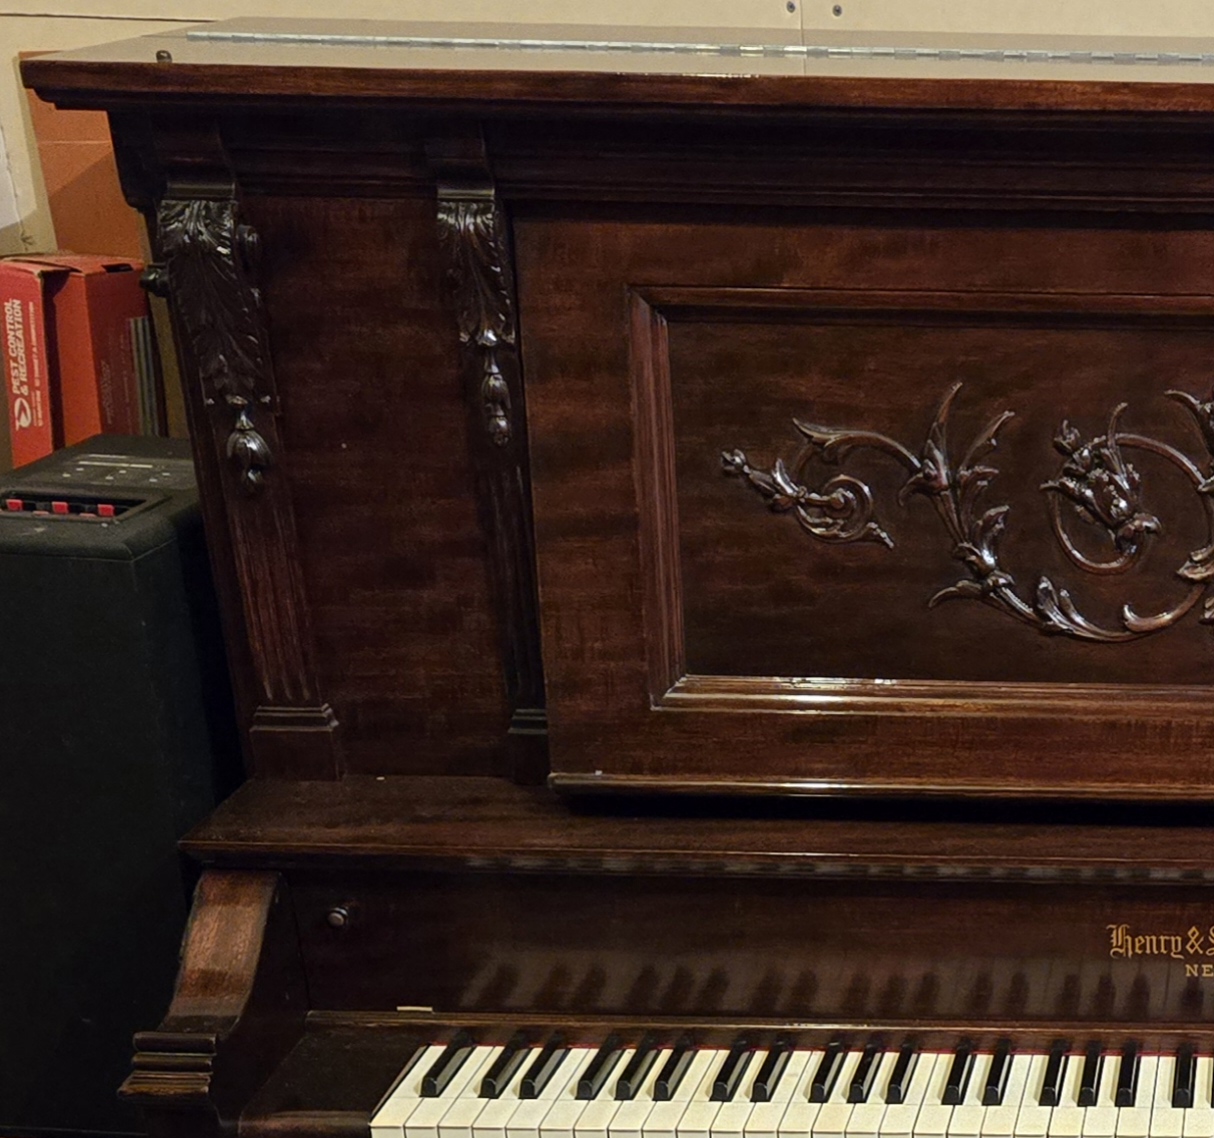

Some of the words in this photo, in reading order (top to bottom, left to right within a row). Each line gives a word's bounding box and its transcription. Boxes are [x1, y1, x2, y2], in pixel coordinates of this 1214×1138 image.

[4, 298, 16, 357] CONTROL
[13, 299, 27, 382] RECREATION
[10, 359, 21, 394] PEST
[20, 384, 29, 396] &
[1106, 924, 1185, 959] Henry
[1185, 926, 1204, 955] &
